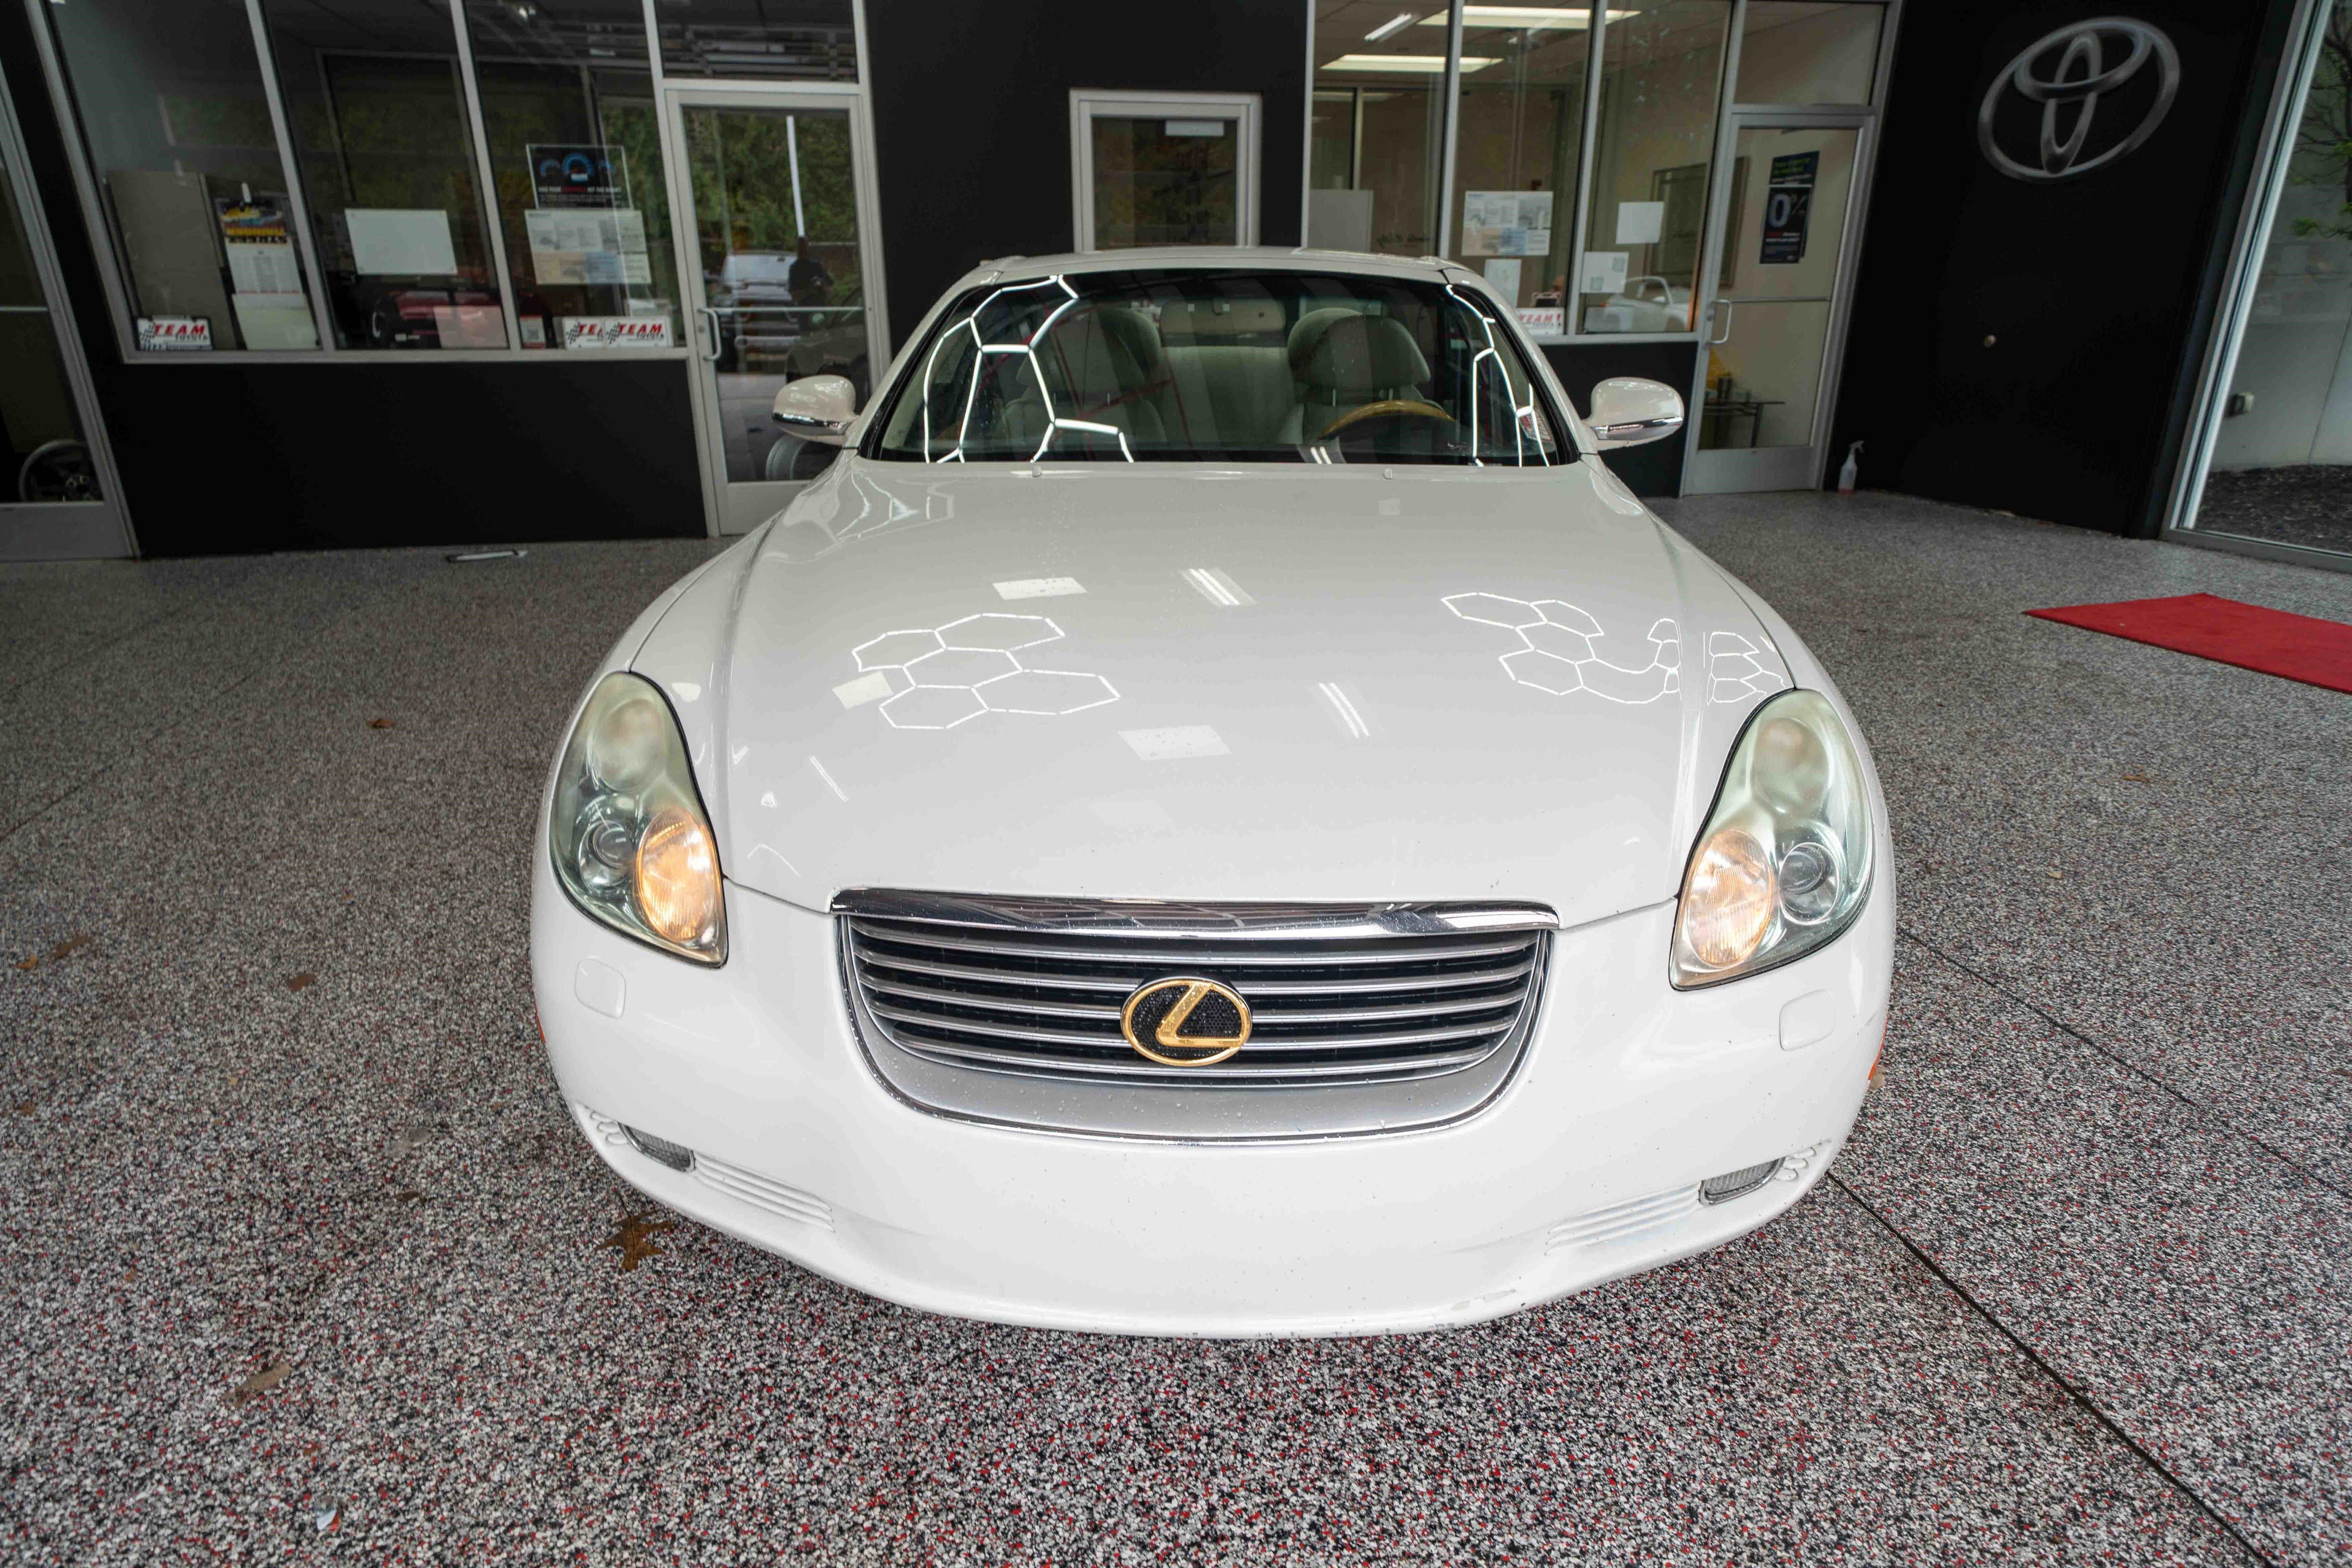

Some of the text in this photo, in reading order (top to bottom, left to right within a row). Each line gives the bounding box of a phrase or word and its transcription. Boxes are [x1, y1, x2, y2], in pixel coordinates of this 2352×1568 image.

[154, 323, 205, 334] TEAM
[579, 323, 602, 334] TE
[619, 323, 662, 334] TEAM
